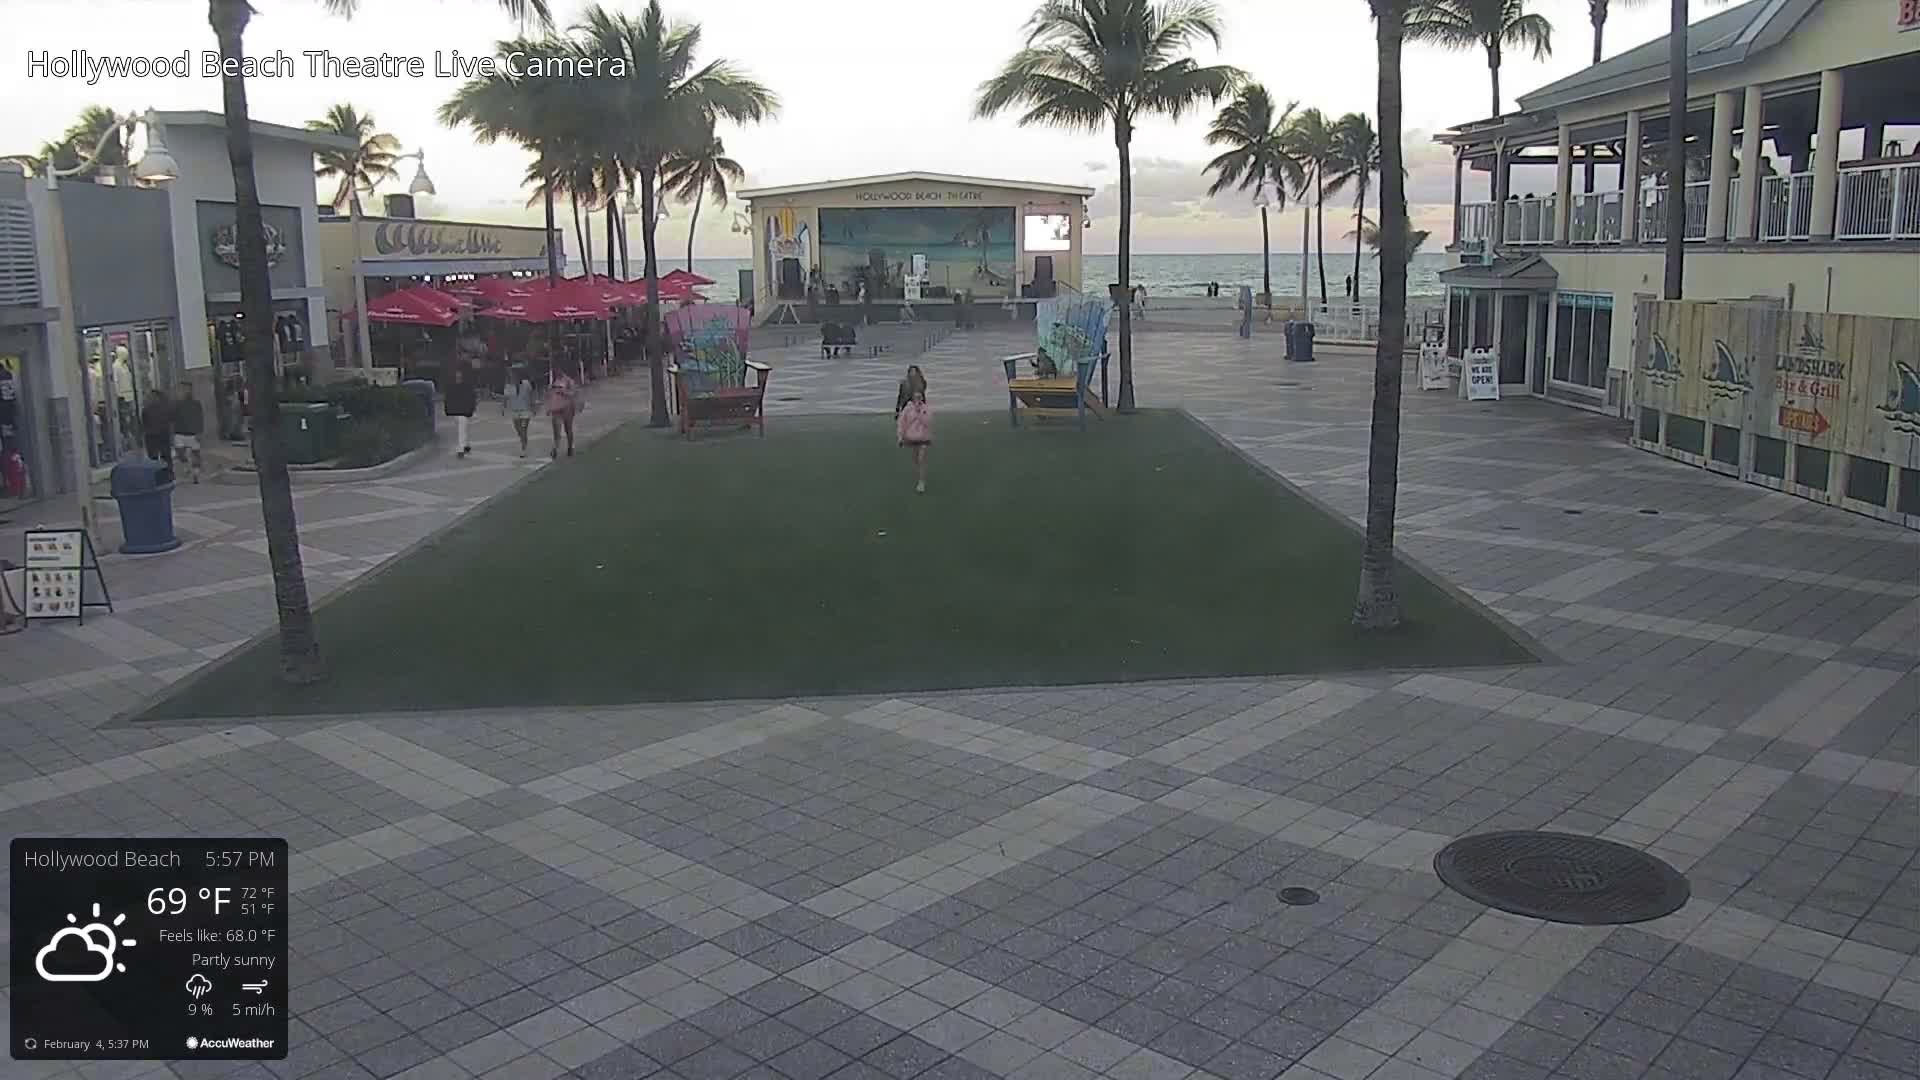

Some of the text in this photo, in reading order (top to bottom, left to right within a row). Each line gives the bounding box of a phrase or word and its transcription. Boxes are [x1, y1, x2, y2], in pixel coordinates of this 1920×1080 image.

[855, 191, 983, 201] HOLLYWOOD BEACH THEATRE
